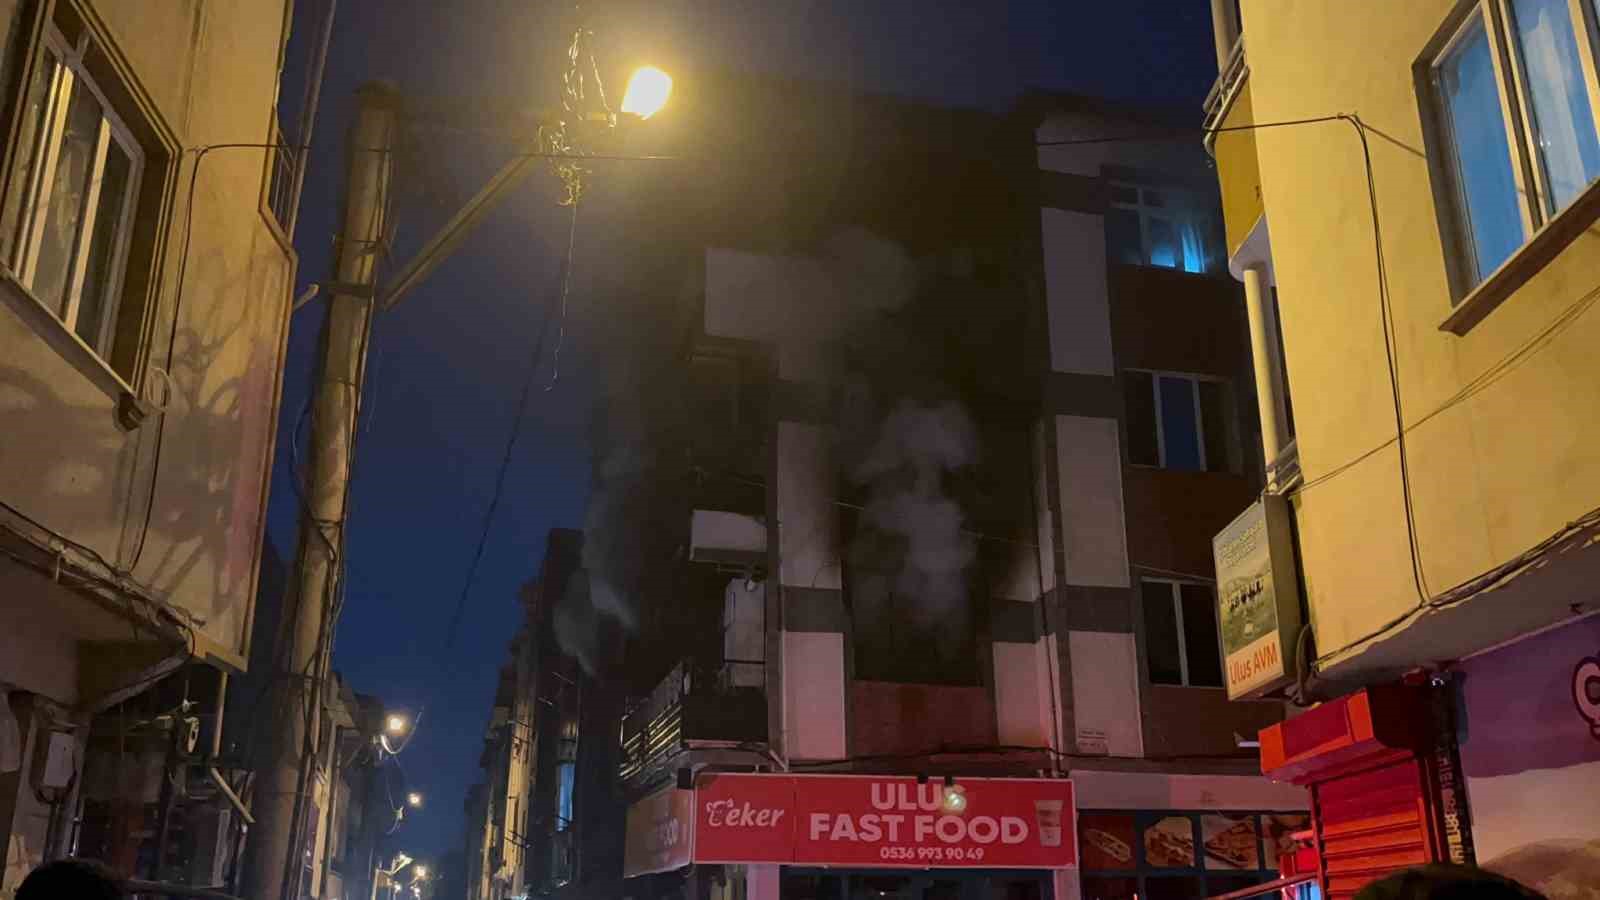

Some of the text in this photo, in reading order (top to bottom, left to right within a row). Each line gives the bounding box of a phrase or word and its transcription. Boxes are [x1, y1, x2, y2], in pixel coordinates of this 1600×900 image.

[1254, 641, 1278, 674] AVM
[810, 813, 1029, 844] FAST FOOD
[880, 847, 984, 860] 0536 993 90 49
